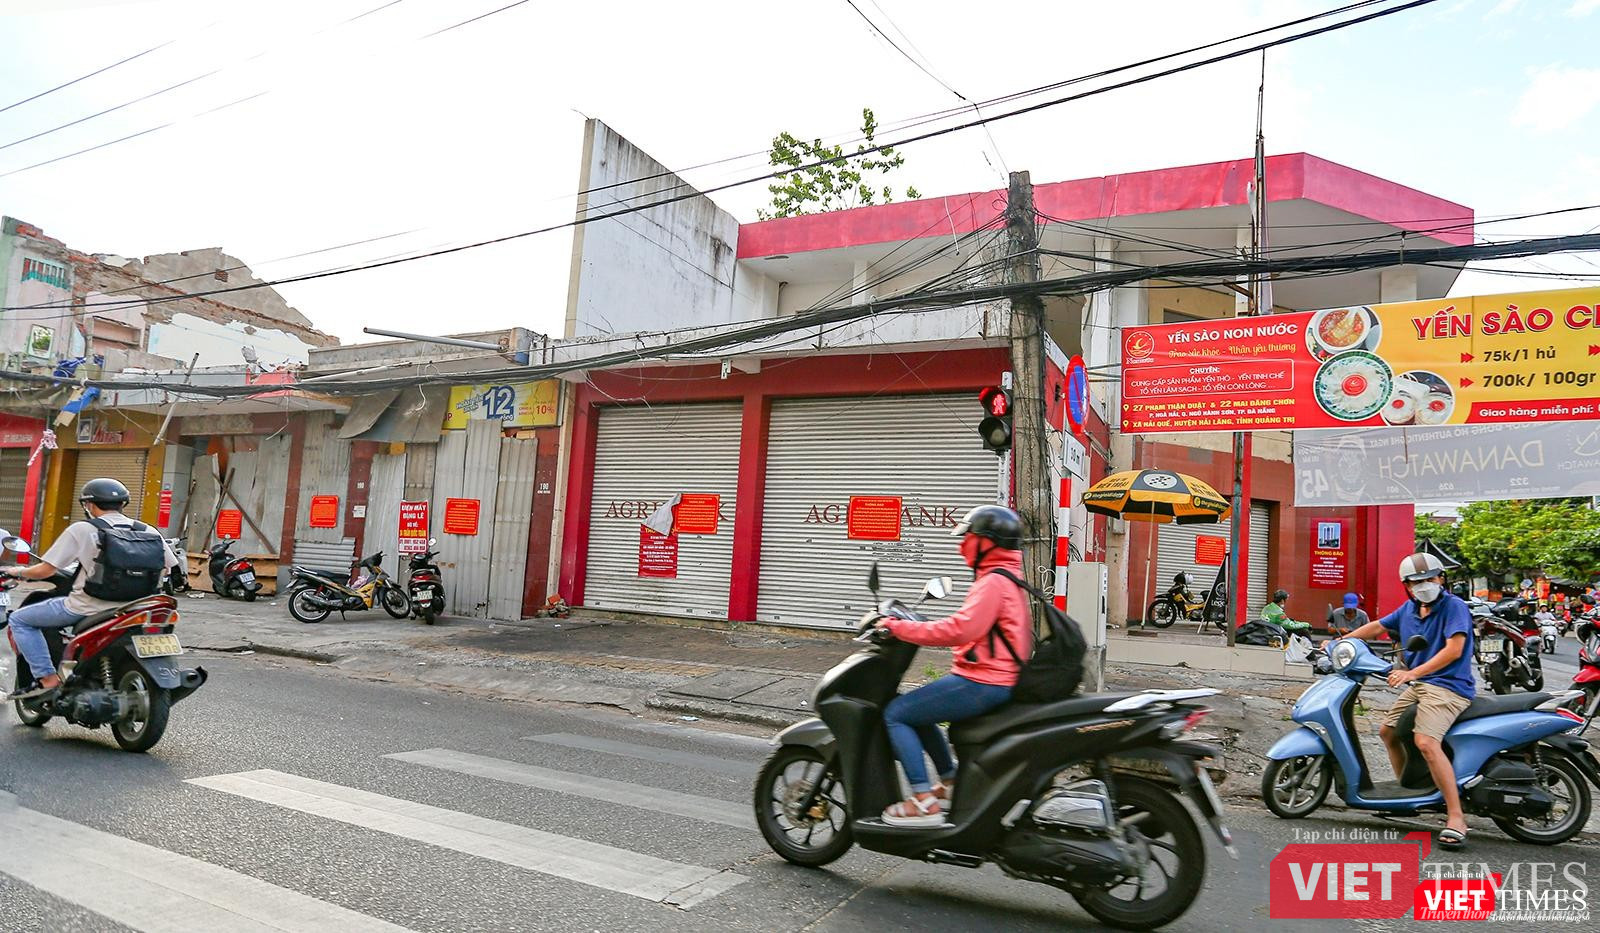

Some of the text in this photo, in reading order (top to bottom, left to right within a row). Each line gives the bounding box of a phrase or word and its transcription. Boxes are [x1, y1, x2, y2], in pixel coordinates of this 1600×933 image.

[1412, 305, 1472, 340] YẾN
[1481, 303, 1555, 336] SÀO
[1168, 322, 1298, 344] YẾN SÀO NON NƯỚC
[1484, 346, 1556, 362] 75k/1 hủ
[1483, 371, 1597, 388] 700k/ 100gr
[484, 386, 515, 419] 12
[1479, 408, 1506, 417] Giao
[1509, 407, 1538, 418] hàng
[1541, 404, 1569, 415] miễn
